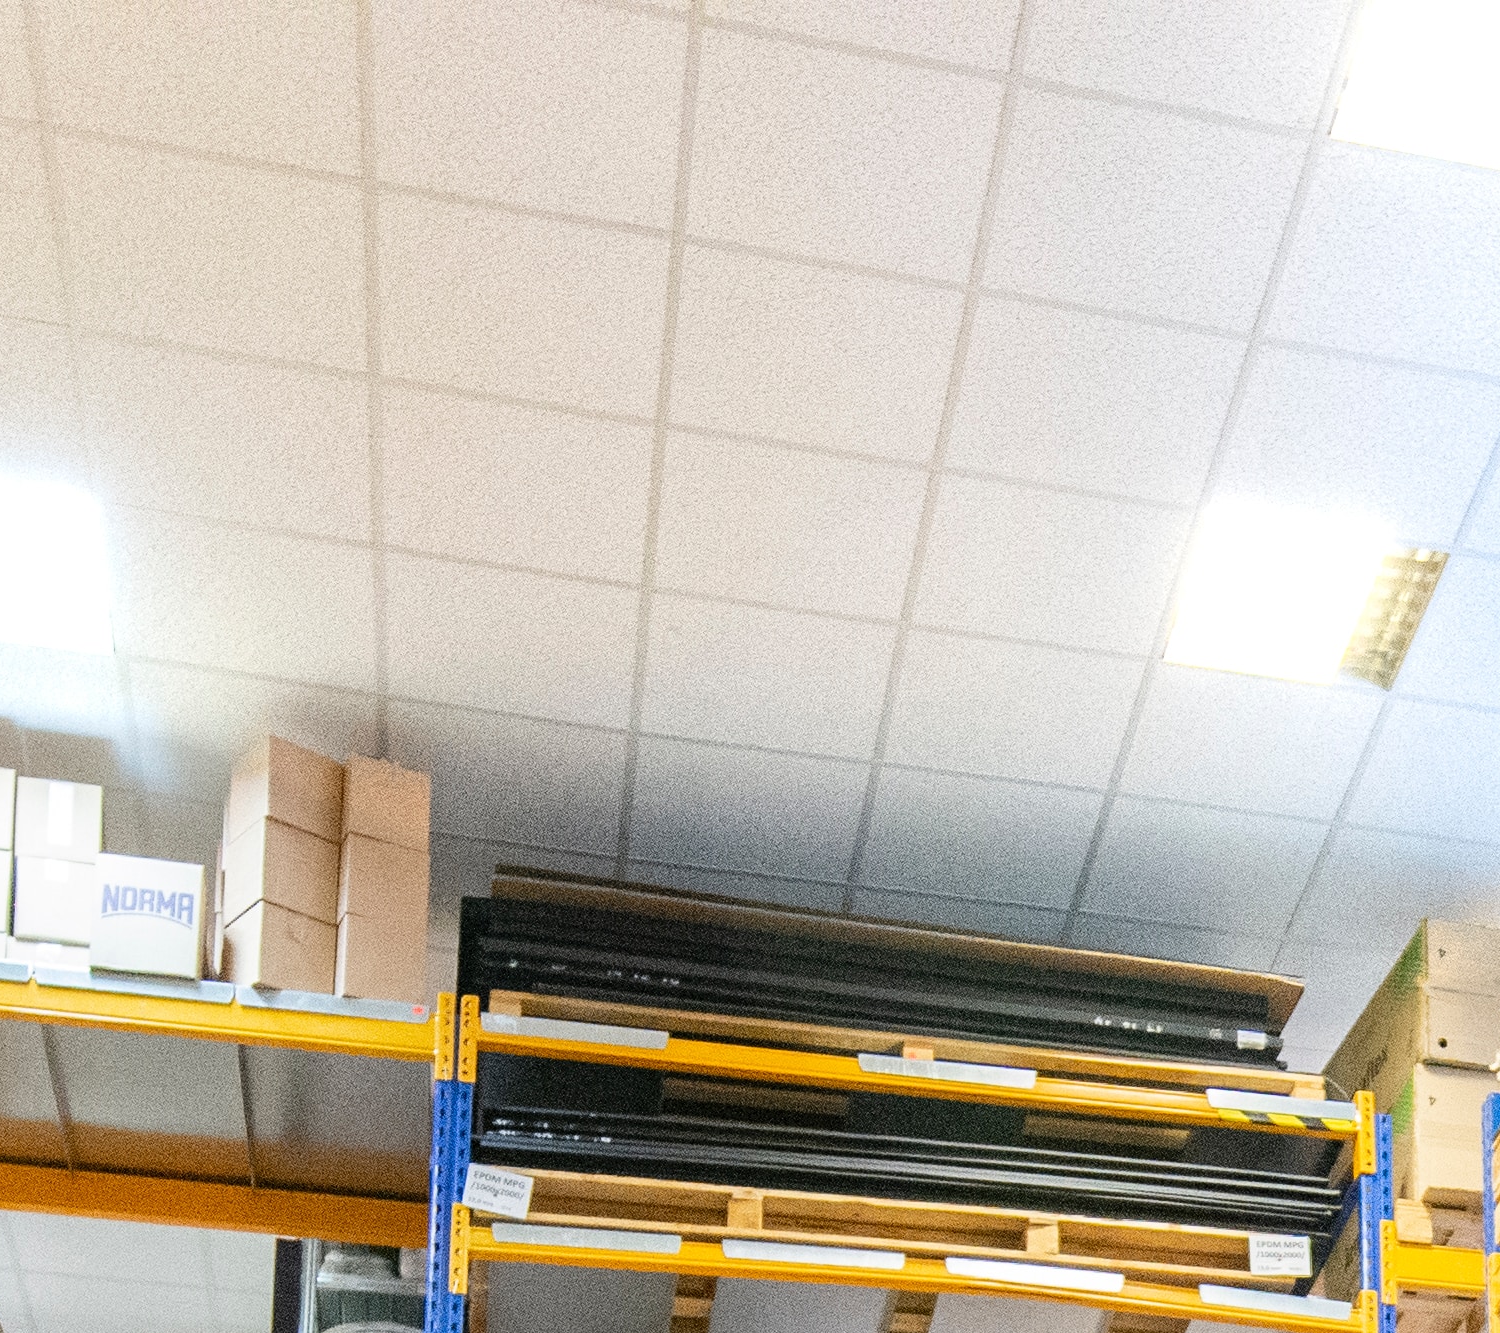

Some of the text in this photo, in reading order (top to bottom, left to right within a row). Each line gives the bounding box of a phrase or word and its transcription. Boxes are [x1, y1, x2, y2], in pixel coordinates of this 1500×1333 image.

[101, 884, 195, 925] NORMA
[473, 1169, 525, 1190] EPDM MPG
[1256, 1240, 1304, 1250] EPDM MPG
